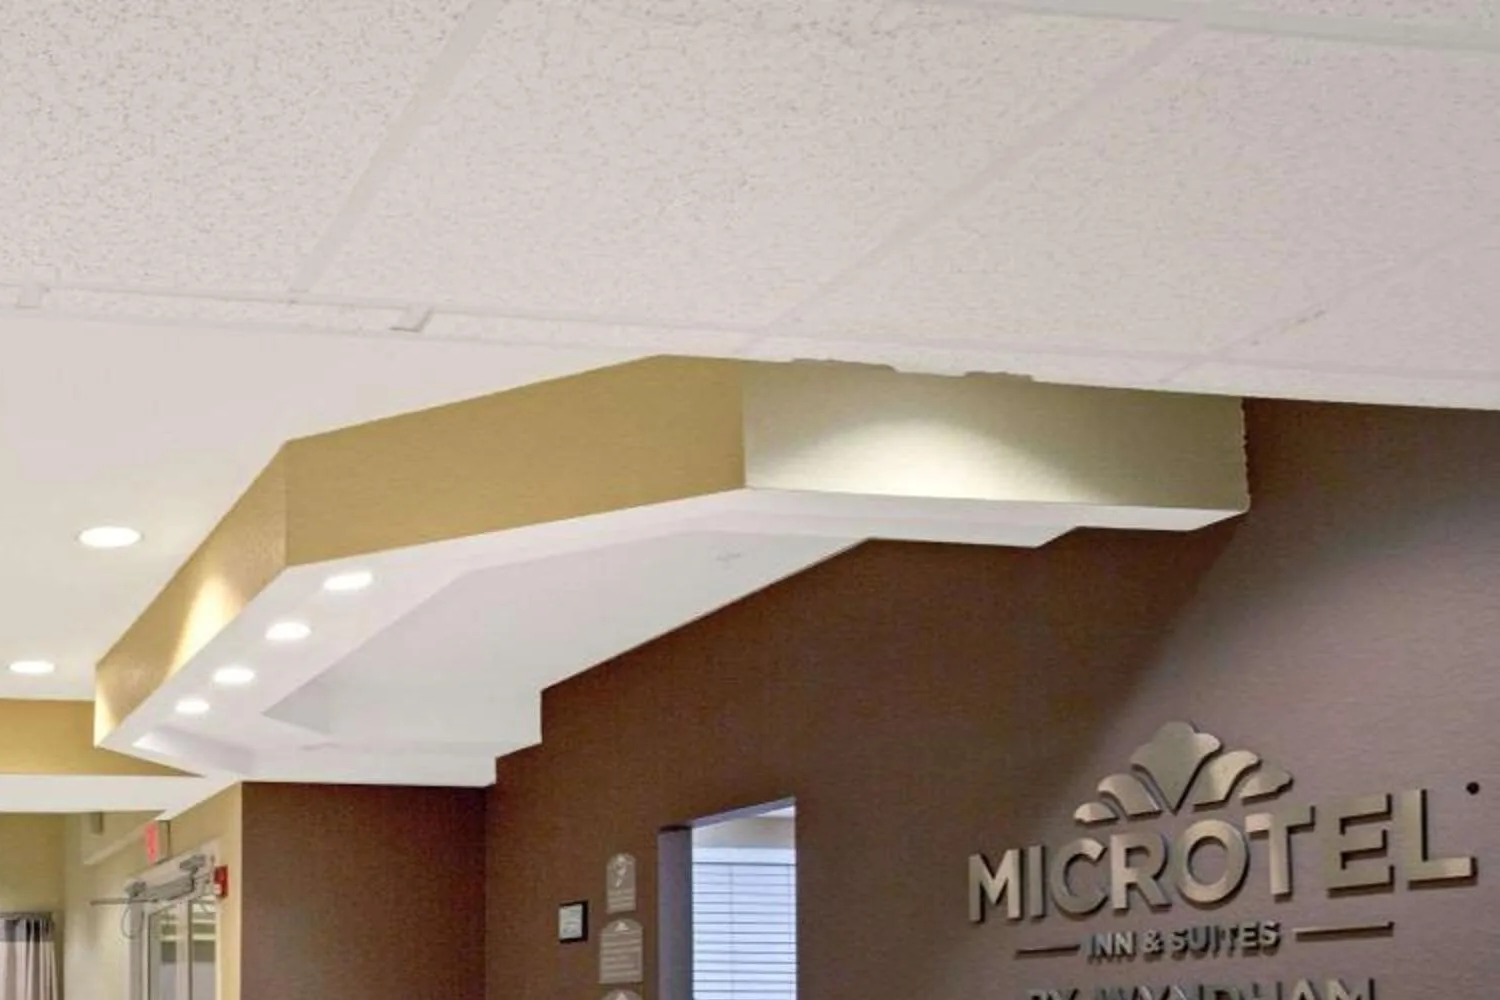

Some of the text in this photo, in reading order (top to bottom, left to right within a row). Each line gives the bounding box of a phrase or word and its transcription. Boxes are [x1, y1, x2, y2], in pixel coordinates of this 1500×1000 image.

[968, 789, 1477, 922] MICROTEL
[1086, 920, 1281, 963] INN & SUITES
